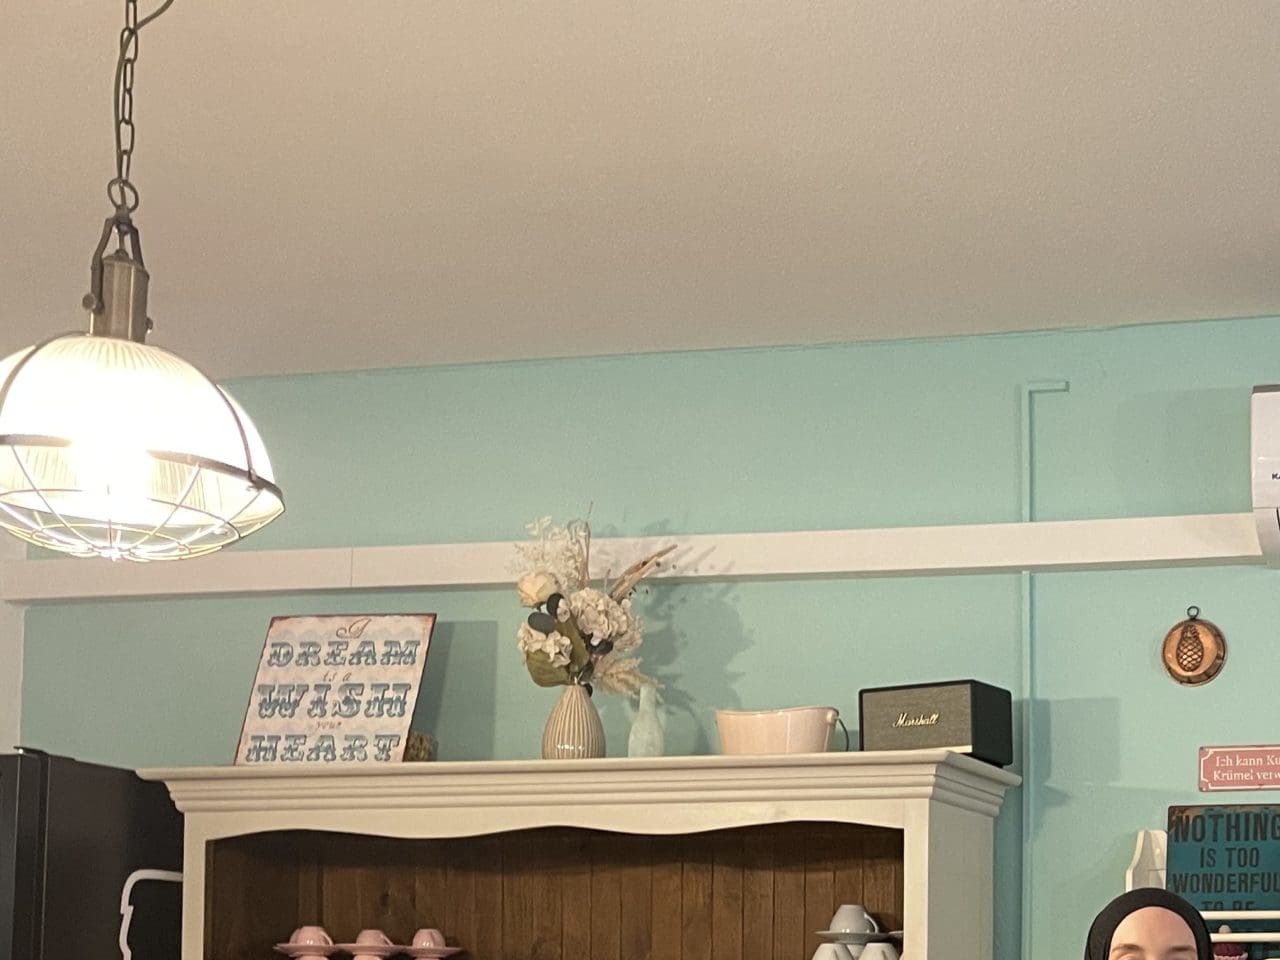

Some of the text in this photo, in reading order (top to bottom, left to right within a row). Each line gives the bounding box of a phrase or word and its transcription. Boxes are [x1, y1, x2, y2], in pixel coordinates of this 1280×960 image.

[267, 640, 420, 667] DREAM
[257, 683, 411, 718] WISH
[892, 713, 940, 728] Marshall
[245, 734, 400, 763] HEART
[1216, 755, 1234, 767] Ich
[1236, 755, 1263, 767] kann
[1213, 768, 1253, 782] Krümel
[1200, 847, 1260, 868] IS TOO
